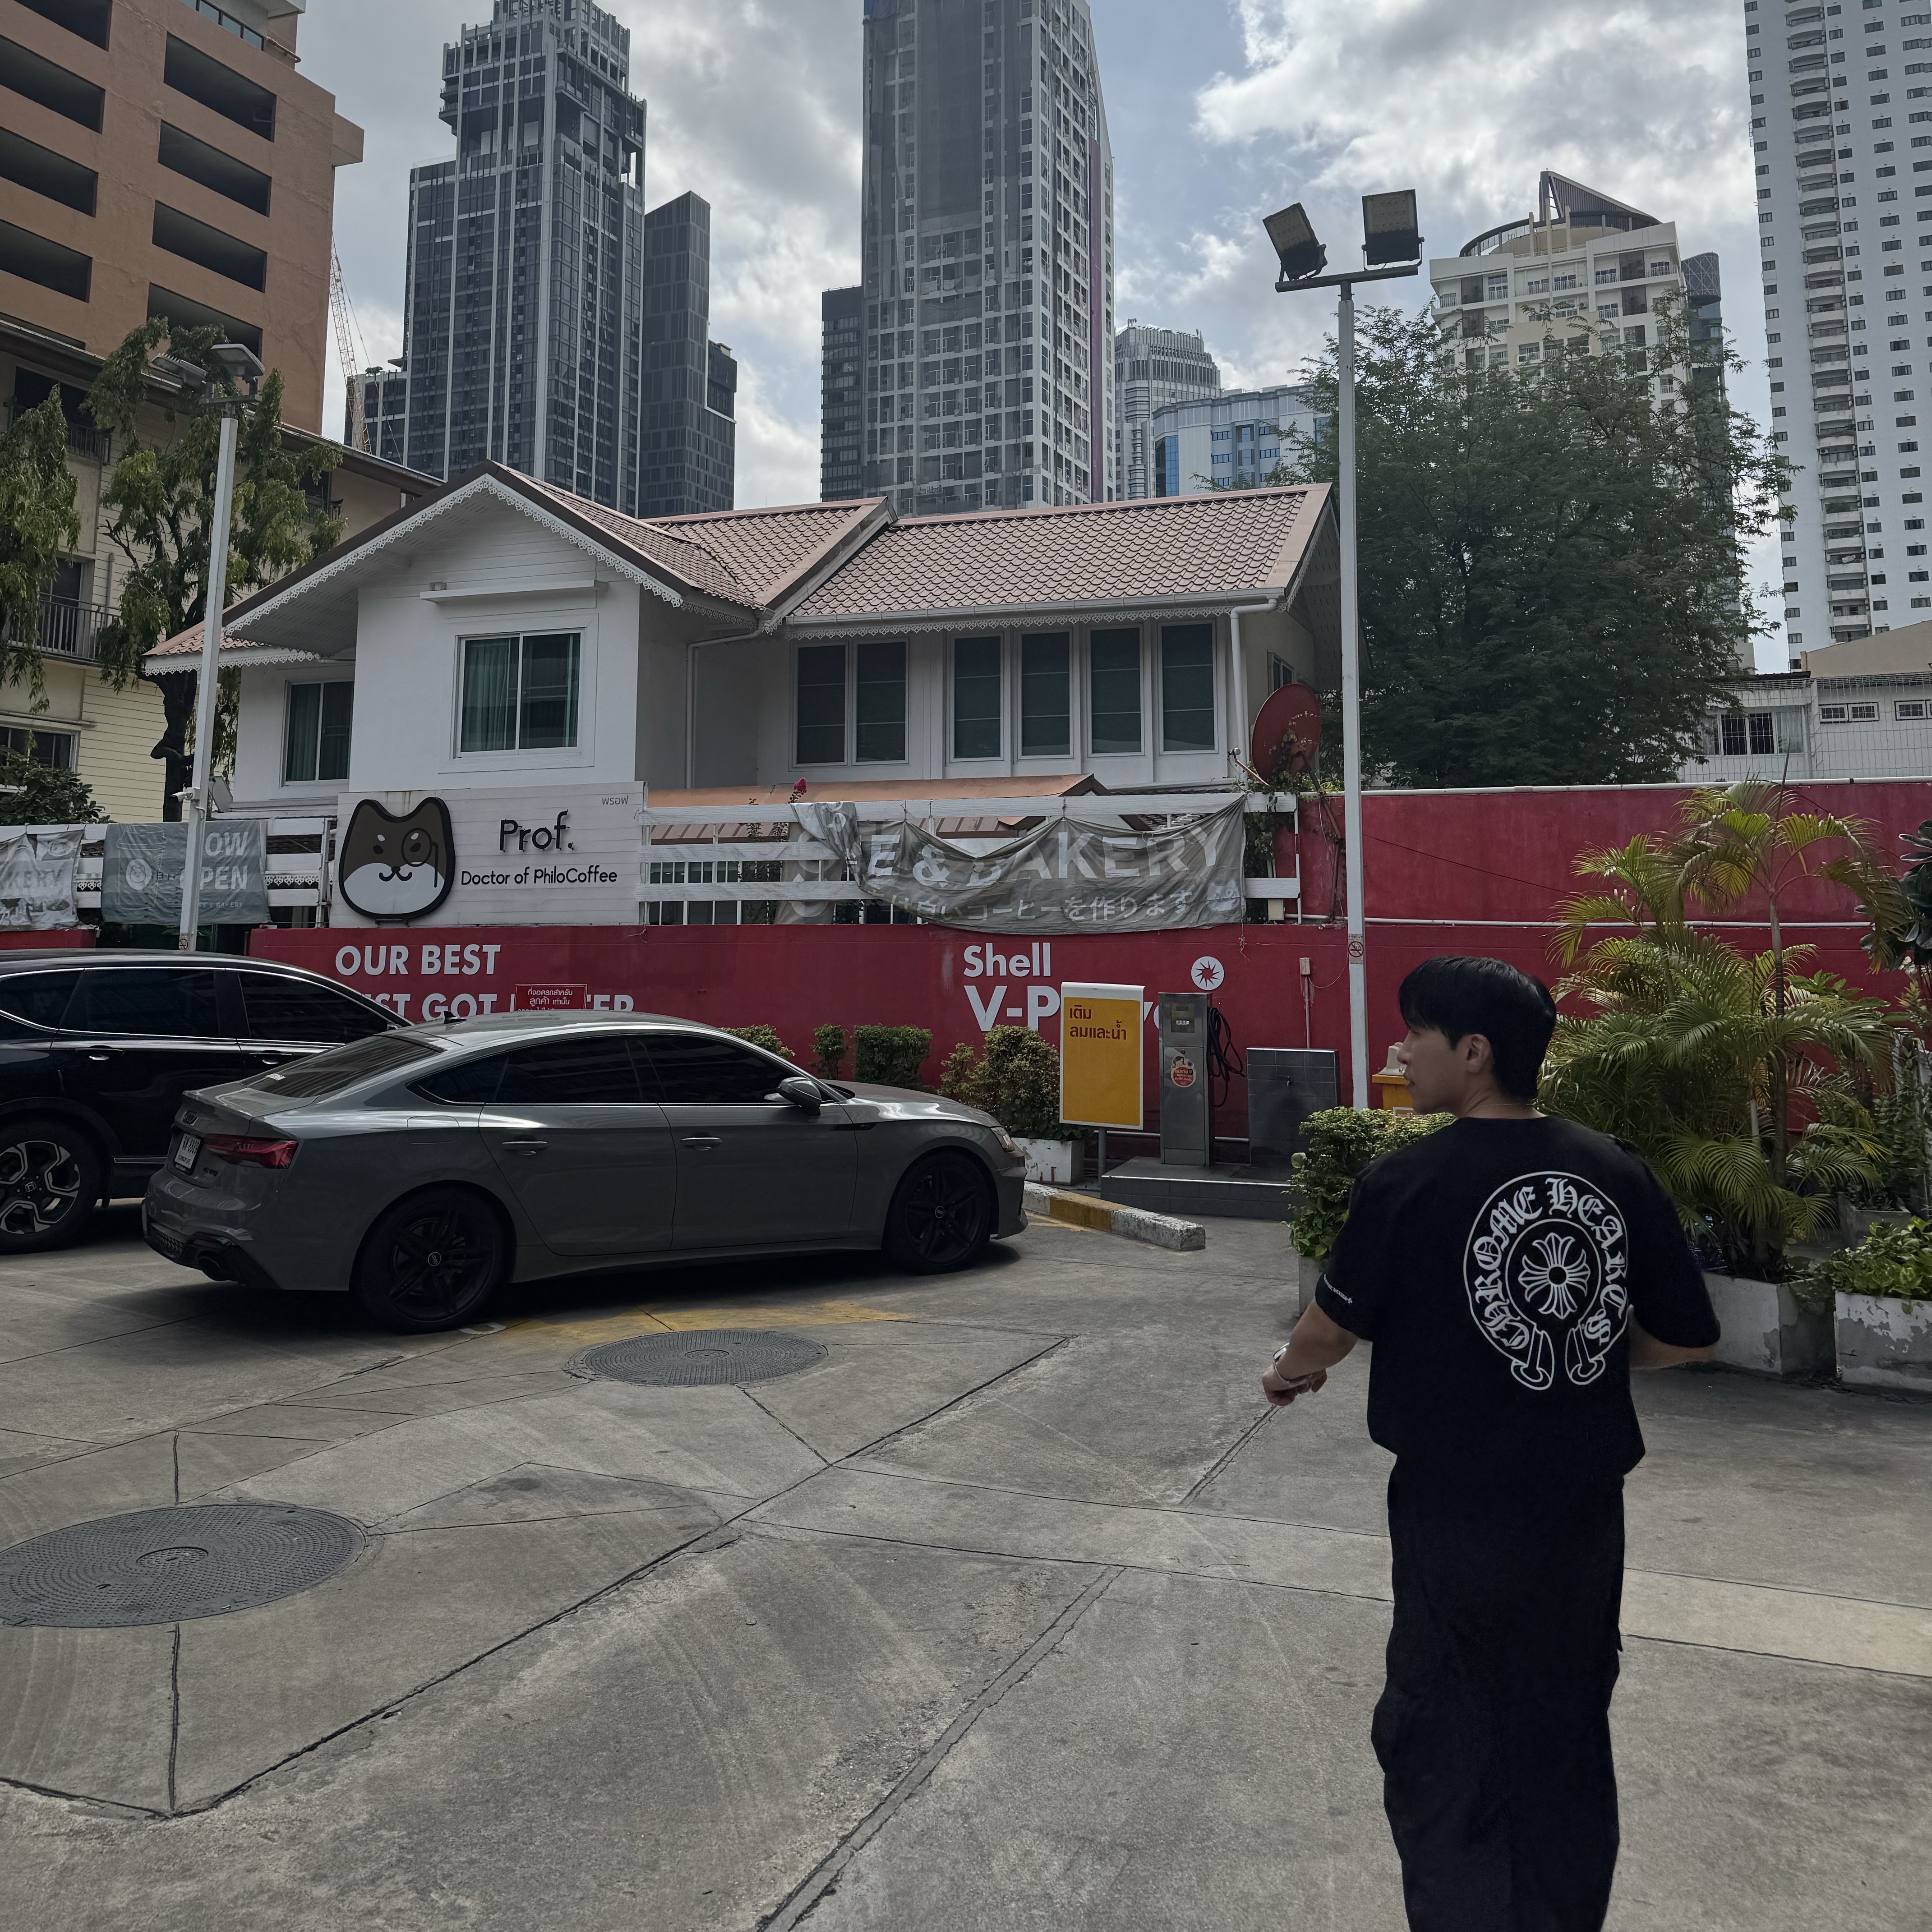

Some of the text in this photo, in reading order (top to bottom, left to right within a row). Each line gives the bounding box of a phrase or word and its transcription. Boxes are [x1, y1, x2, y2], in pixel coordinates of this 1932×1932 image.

[602, 795, 628, 805] พรอฟ
[499, 810, 573, 852] Prof.
[205, 832, 249, 856] OW
[180, 865, 248, 891] PEN
[461, 865, 618, 885] Doctor of PhiloCoffee
[335, 944, 501, 976] OUR BEST
[964, 942, 1051, 977] Shell
[422, 993, 497, 1022] GOT
[530, 996, 549, 1007] ลูกค้า
[1070, 1005, 1092, 1020] เติม
[1070, 1020, 1127, 1040] ลมและน้ำ
[1473, 1186, 1543, 1349] CHROME
